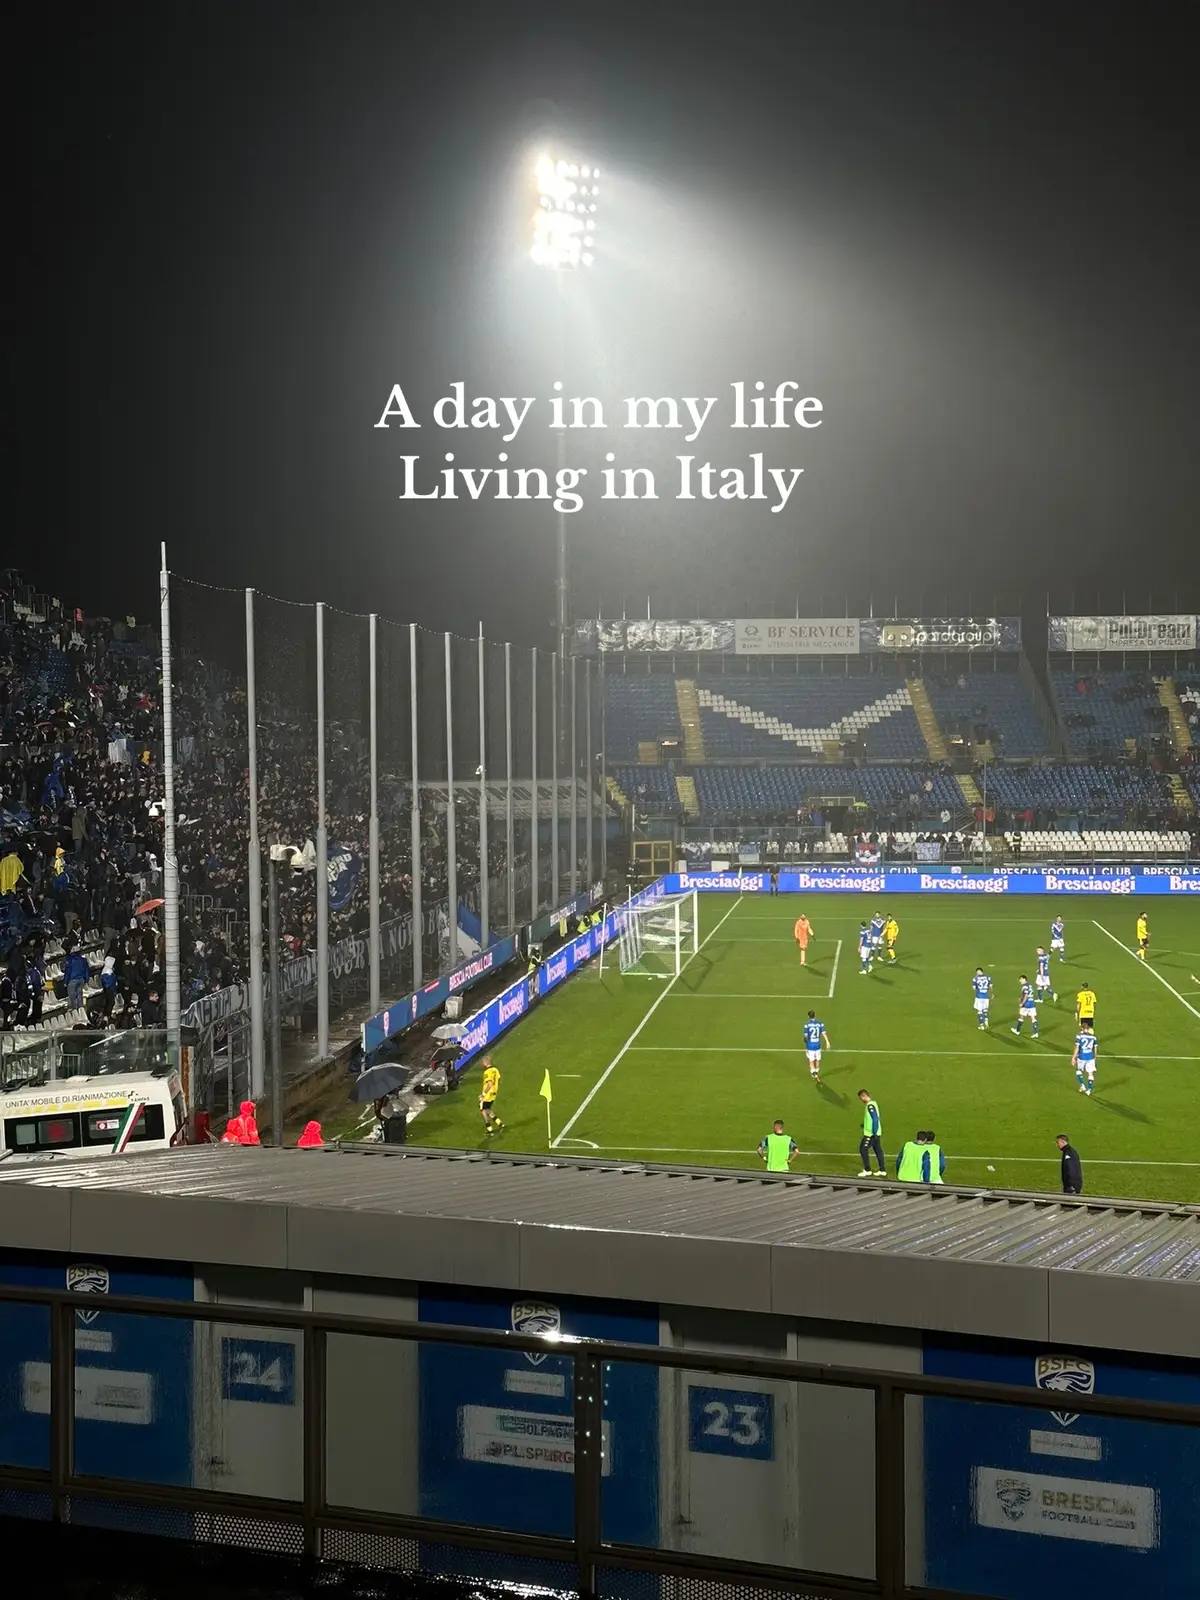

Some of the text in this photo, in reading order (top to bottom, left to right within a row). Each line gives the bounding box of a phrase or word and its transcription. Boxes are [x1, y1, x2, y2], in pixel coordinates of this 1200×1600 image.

[767, 626, 856, 639] BF SERVICE
[1108, 638, 1191, 649] IMPRESA DI PULIZIE
[1143, 867, 1190, 875] BRESCIA
[679, 874, 763, 892] Bresciaoggi
[799, 874, 885, 892] Bresciaoggi
[921, 875, 1009, 893] Bresciaoggi
[1046, 876, 1136, 894] Bresciaoggi
[976, 979, 988, 990] 32
[809, 1026, 820, 1039] 21
[1081, 1038, 1094, 1050] 24
[32, 1096, 60, 1106] MOBILE
[72, 1090, 127, 1103] RIANIMAZIONE
[513, 1303, 558, 1322] BSFC
[233, 1350, 286, 1393] 24
[1038, 1357, 1092, 1377] BSFC
[703, 1400, 764, 1446] 23
